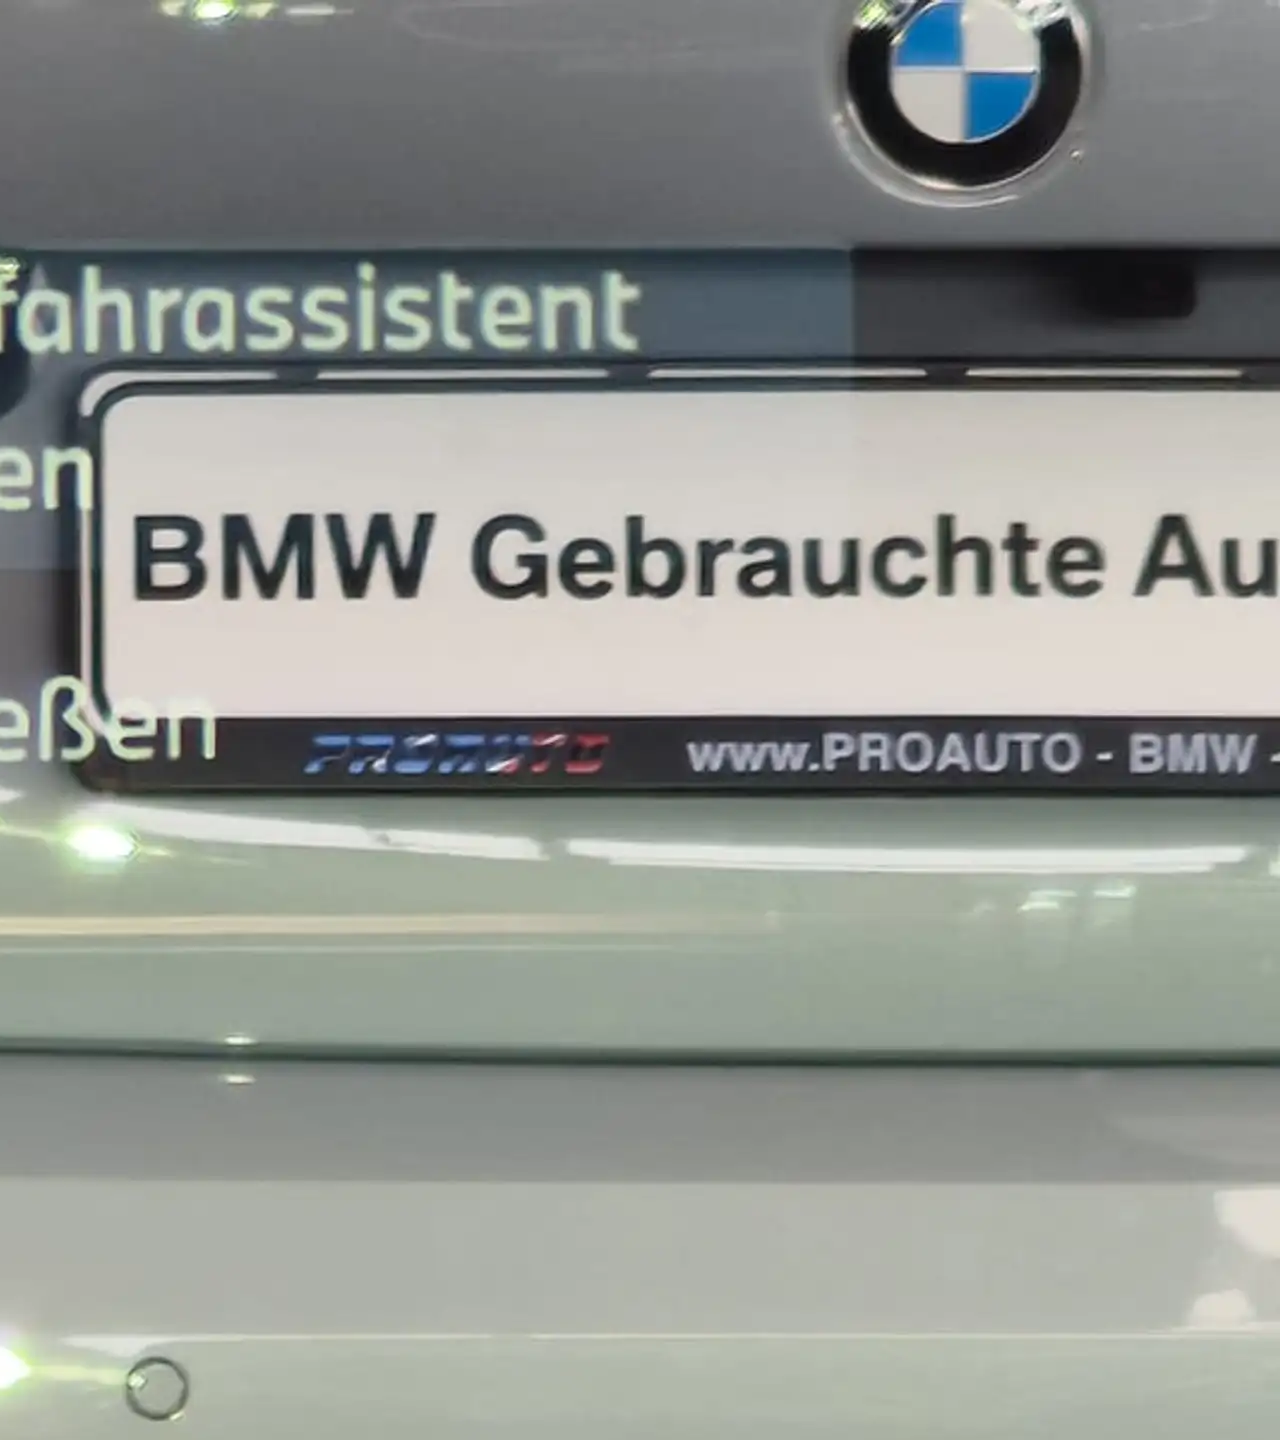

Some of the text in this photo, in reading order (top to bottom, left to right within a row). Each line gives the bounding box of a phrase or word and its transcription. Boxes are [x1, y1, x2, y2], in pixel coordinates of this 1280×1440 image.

[133, 512, 438, 601] BMW
[470, 512, 1106, 600] Gebrauchte
[686, 731, 1083, 775] www.PROAUTO
[1128, 732, 1258, 776] BMW
